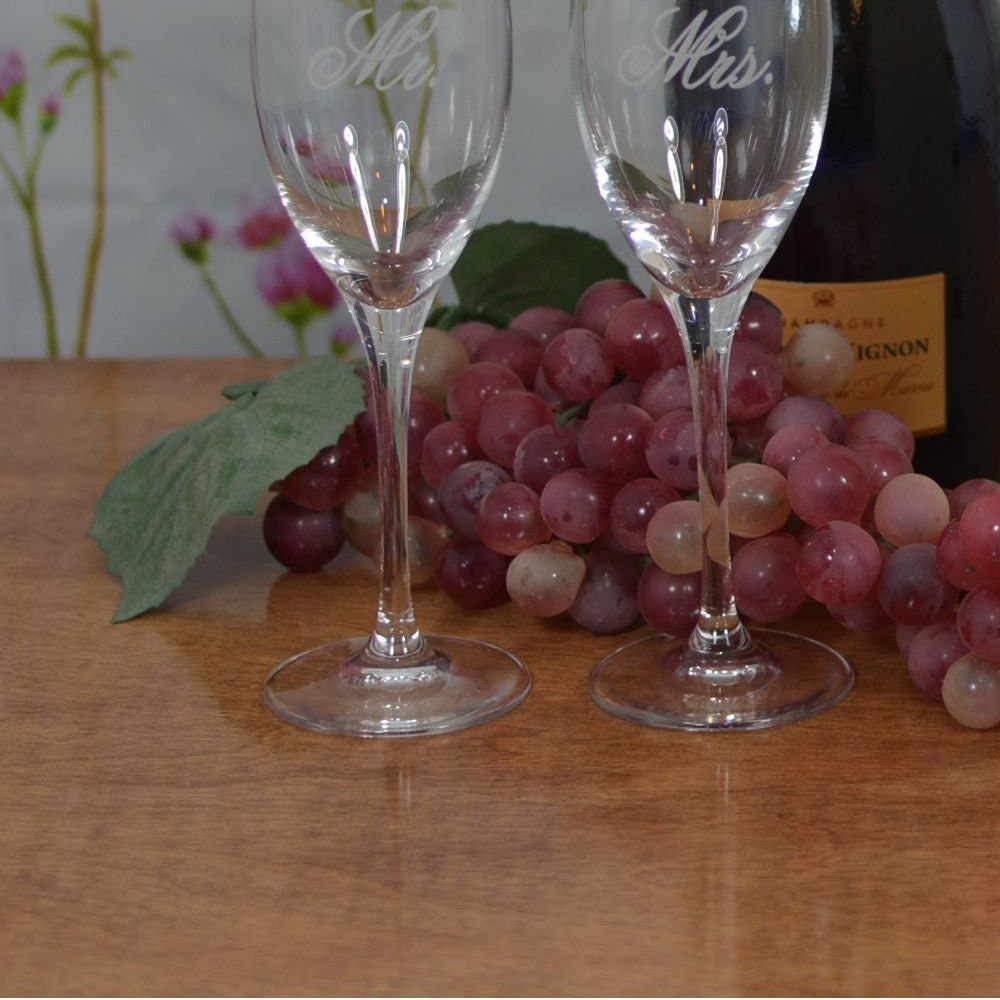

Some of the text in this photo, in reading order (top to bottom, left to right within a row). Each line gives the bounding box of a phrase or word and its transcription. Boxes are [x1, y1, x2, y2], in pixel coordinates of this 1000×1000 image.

[307, 5, 440, 92] Mr.
[617, 5, 773, 91] Mrs.
[850, 337, 930, 361] IGNON
